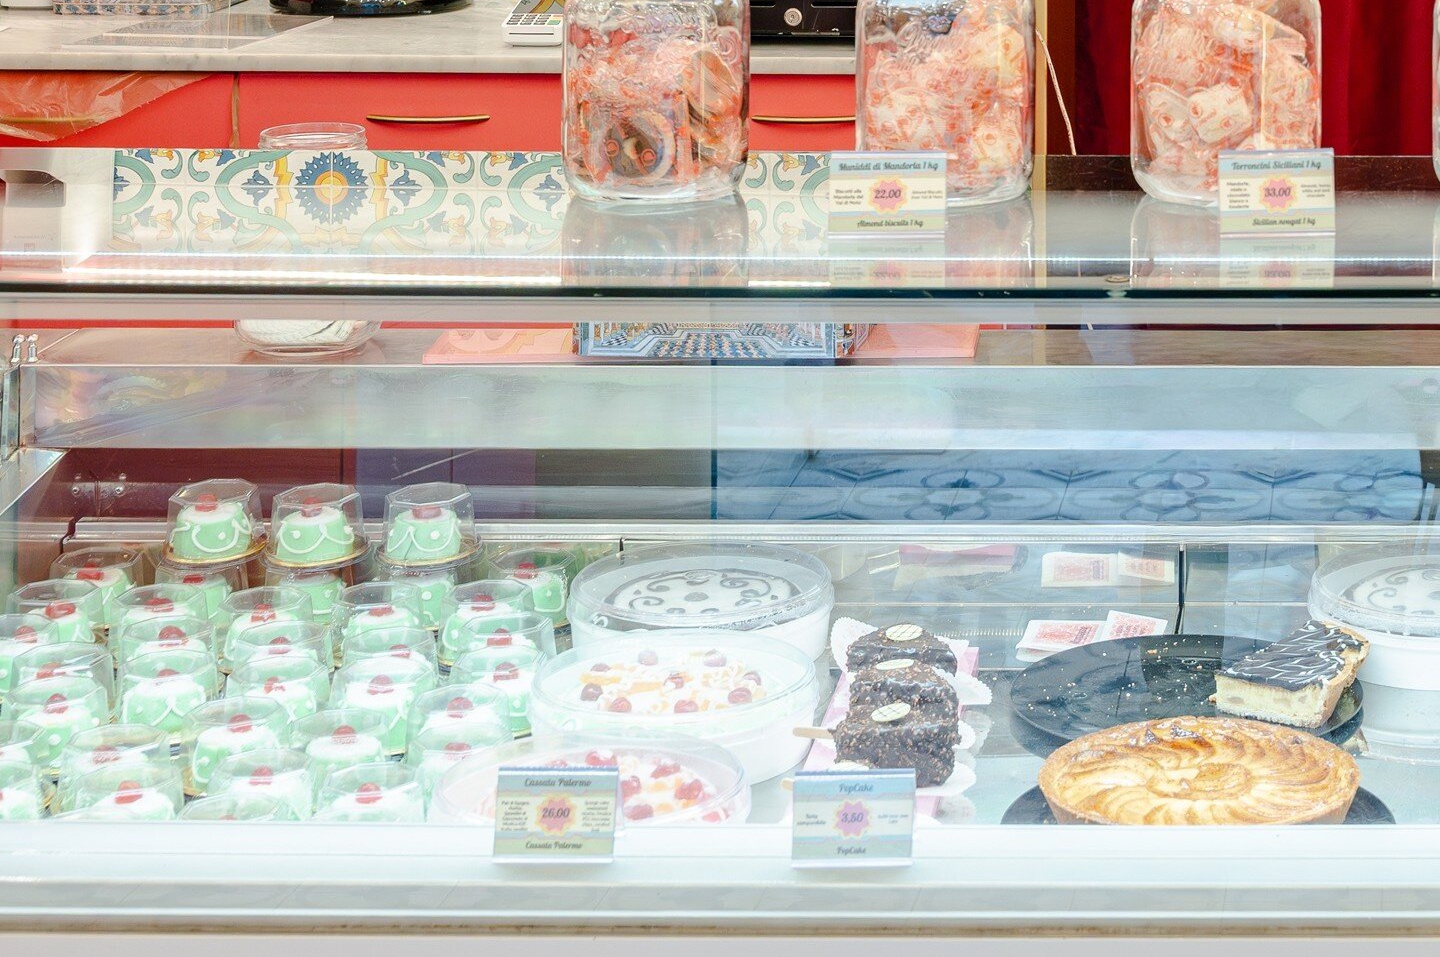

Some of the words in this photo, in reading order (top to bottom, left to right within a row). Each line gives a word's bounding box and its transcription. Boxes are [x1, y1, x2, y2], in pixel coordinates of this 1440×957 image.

[883, 161, 921, 169] Mandorla
[927, 161, 938, 171] kg
[1231, 162, 1271, 170] Torroncini
[1272, 161, 1304, 169] Siciliani
[1311, 160, 1321, 169] kg
[874, 189, 902, 200] 22,00
[1264, 187, 1292, 199] 33,00
[885, 219, 908, 227] biscuits
[914, 219, 923, 227] kg
[1279, 218, 1302, 227] nougat
[1307, 218, 1315, 226] kg
[524, 778, 556, 787] Cassata
[558, 778, 592, 787] Palermo
[839, 784, 874, 794] PopCake
[541, 807, 570, 819] 26,00
[841, 812, 864, 823] 3,50
[525, 841, 552, 849] Cassata
[554, 841, 583, 849] Palermo
[837, 847, 866, 855] PopCake
